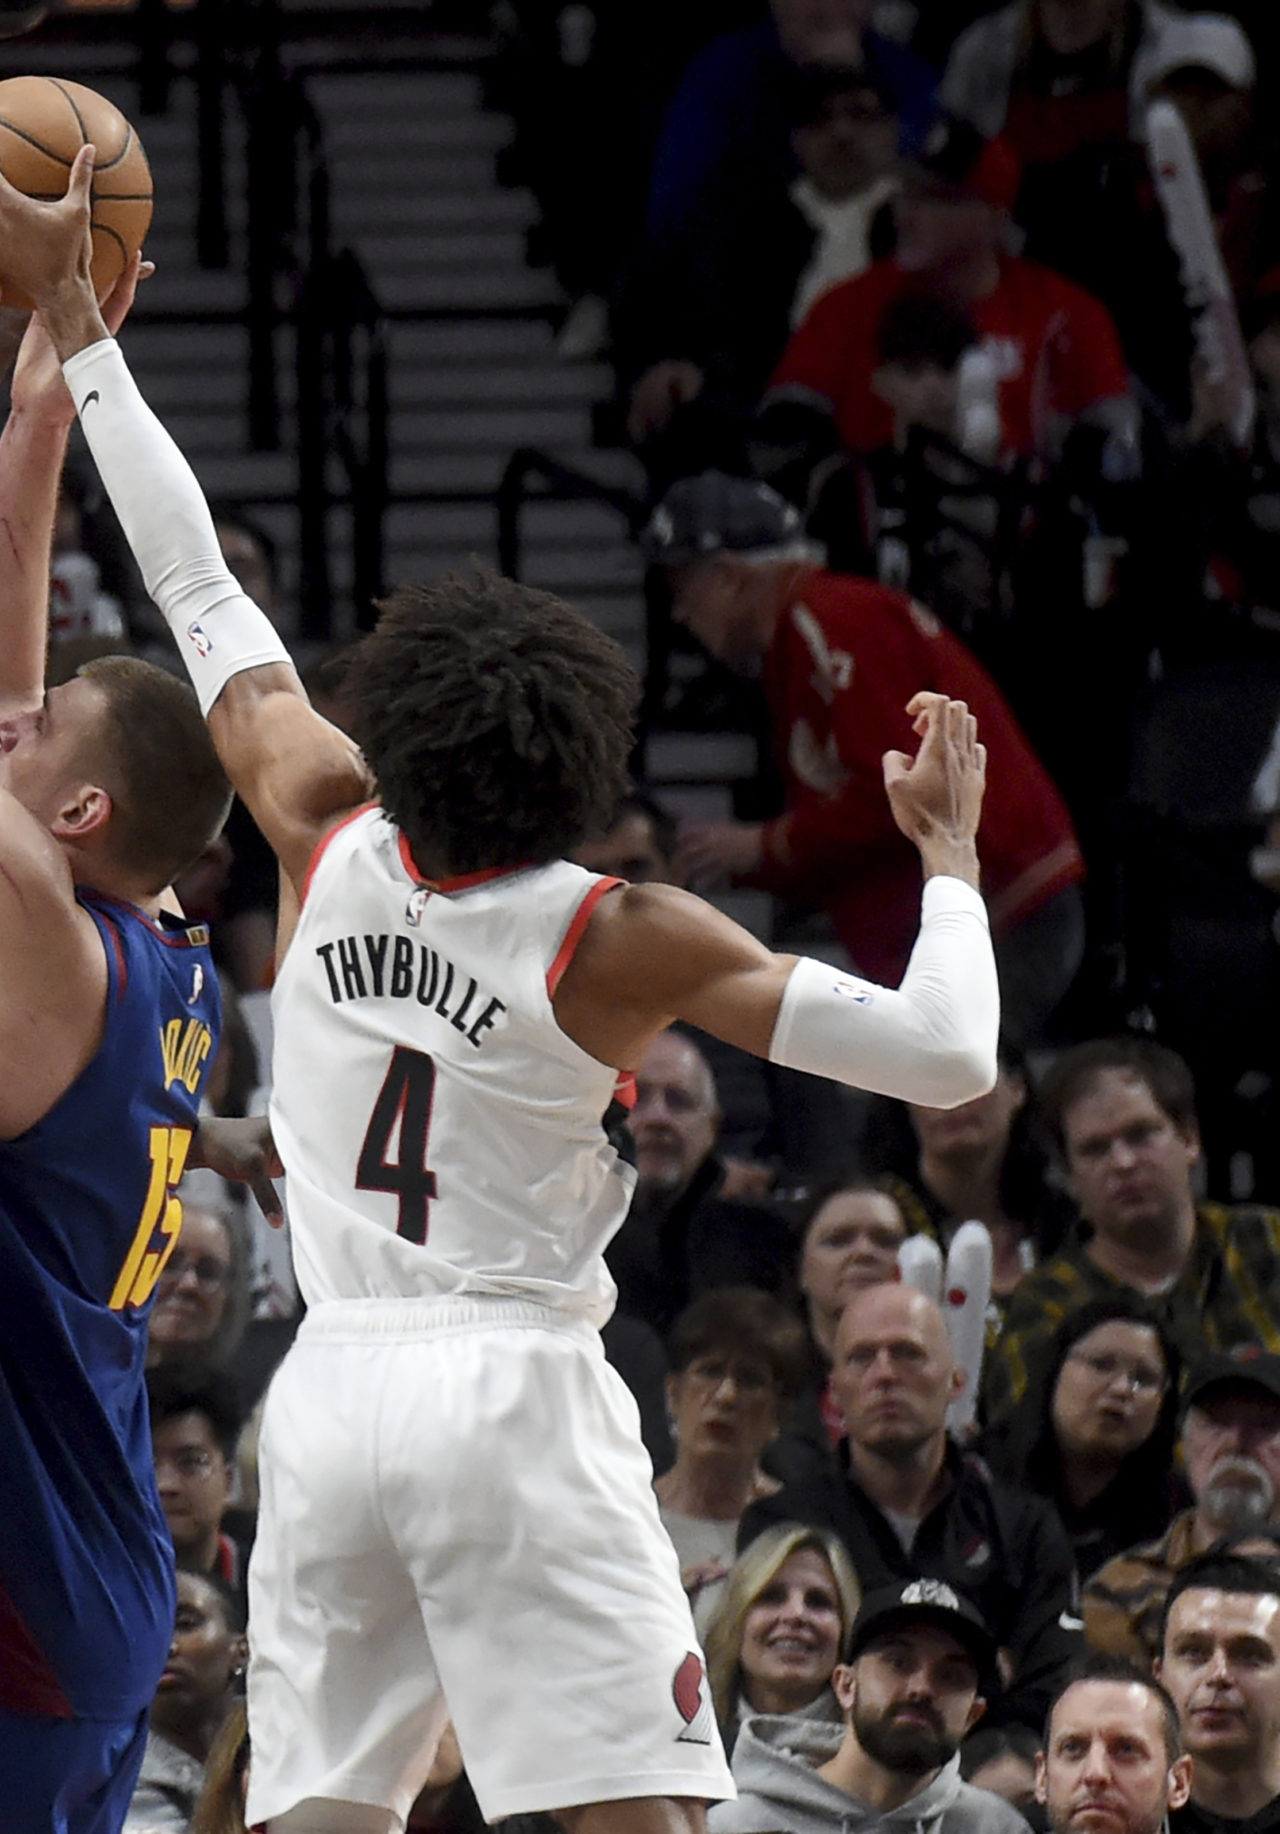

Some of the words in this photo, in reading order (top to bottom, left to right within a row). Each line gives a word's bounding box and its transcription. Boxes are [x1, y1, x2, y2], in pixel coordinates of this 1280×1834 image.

[316, 934, 507, 1049] THYBULLE
[107, 1126, 193, 1311] 15
[355, 1044, 438, 1246] 4
